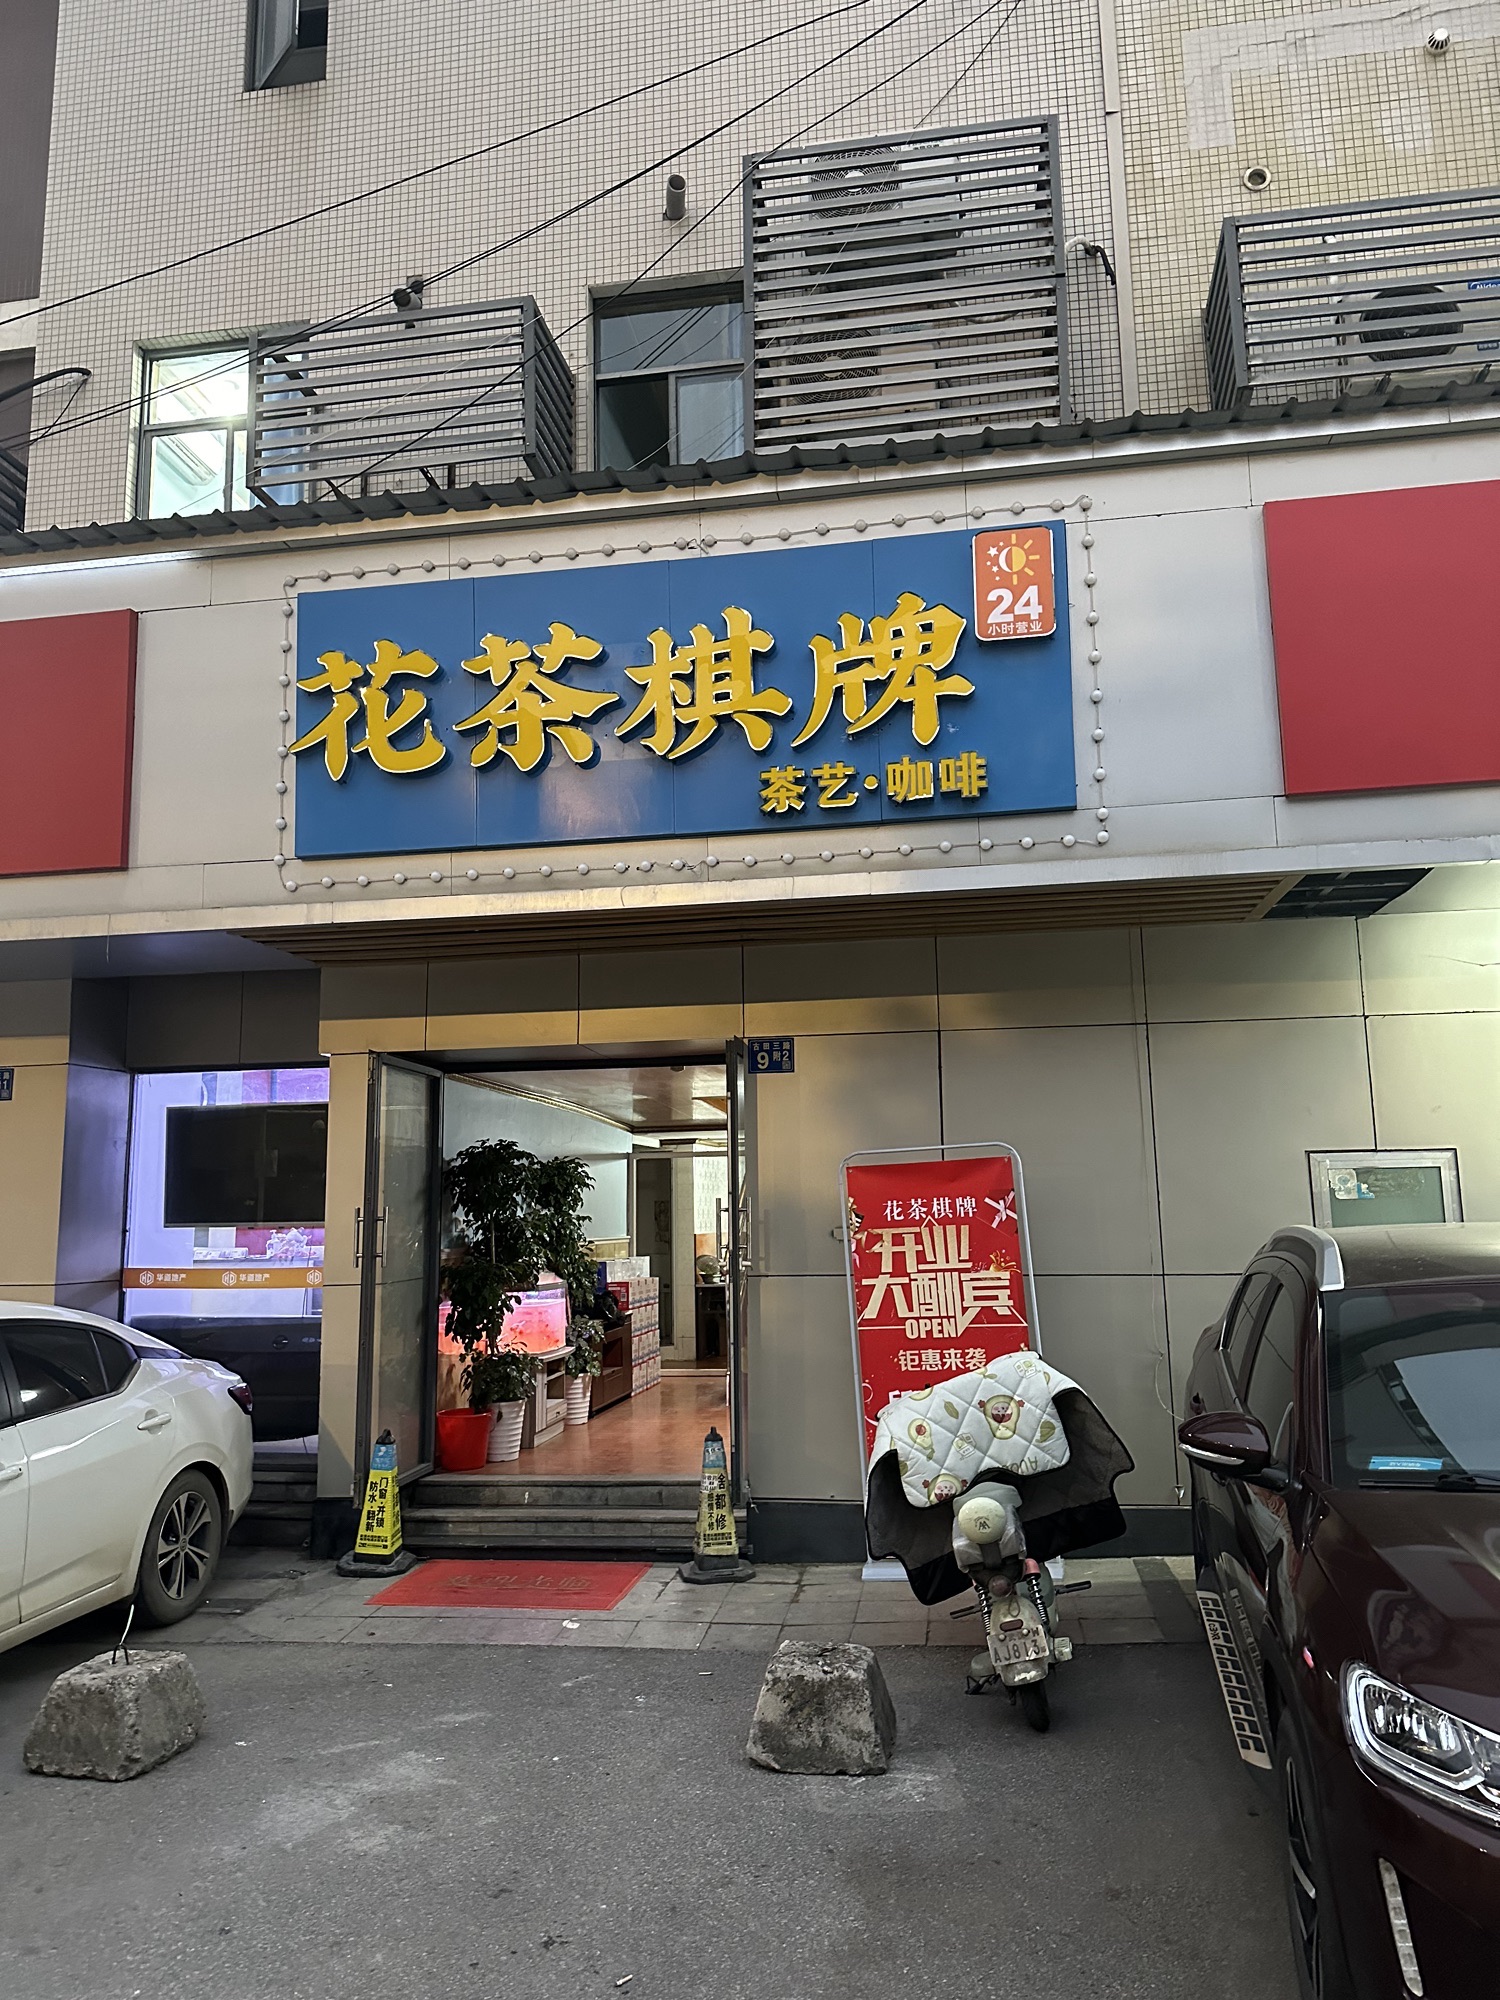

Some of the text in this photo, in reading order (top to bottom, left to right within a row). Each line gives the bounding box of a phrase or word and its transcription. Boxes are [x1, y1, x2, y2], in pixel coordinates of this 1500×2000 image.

[987, 585, 1043, 624] 24
[988, 621, 1042, 635] 小时营业
[290, 591, 976, 782] 花茶棋牌
[759, 751, 988, 813] 茶艺·咖啡
[757, 1051, 769, 1070] 9
[883, 1196, 978, 1222] 花茶棋牌
[873, 1224, 973, 1273] 开业
[862, 1271, 1014, 1321] 大酬宾
[905, 1319, 956, 1339] OPEN
[899, 1348, 987, 1372] 钜惠来袭
